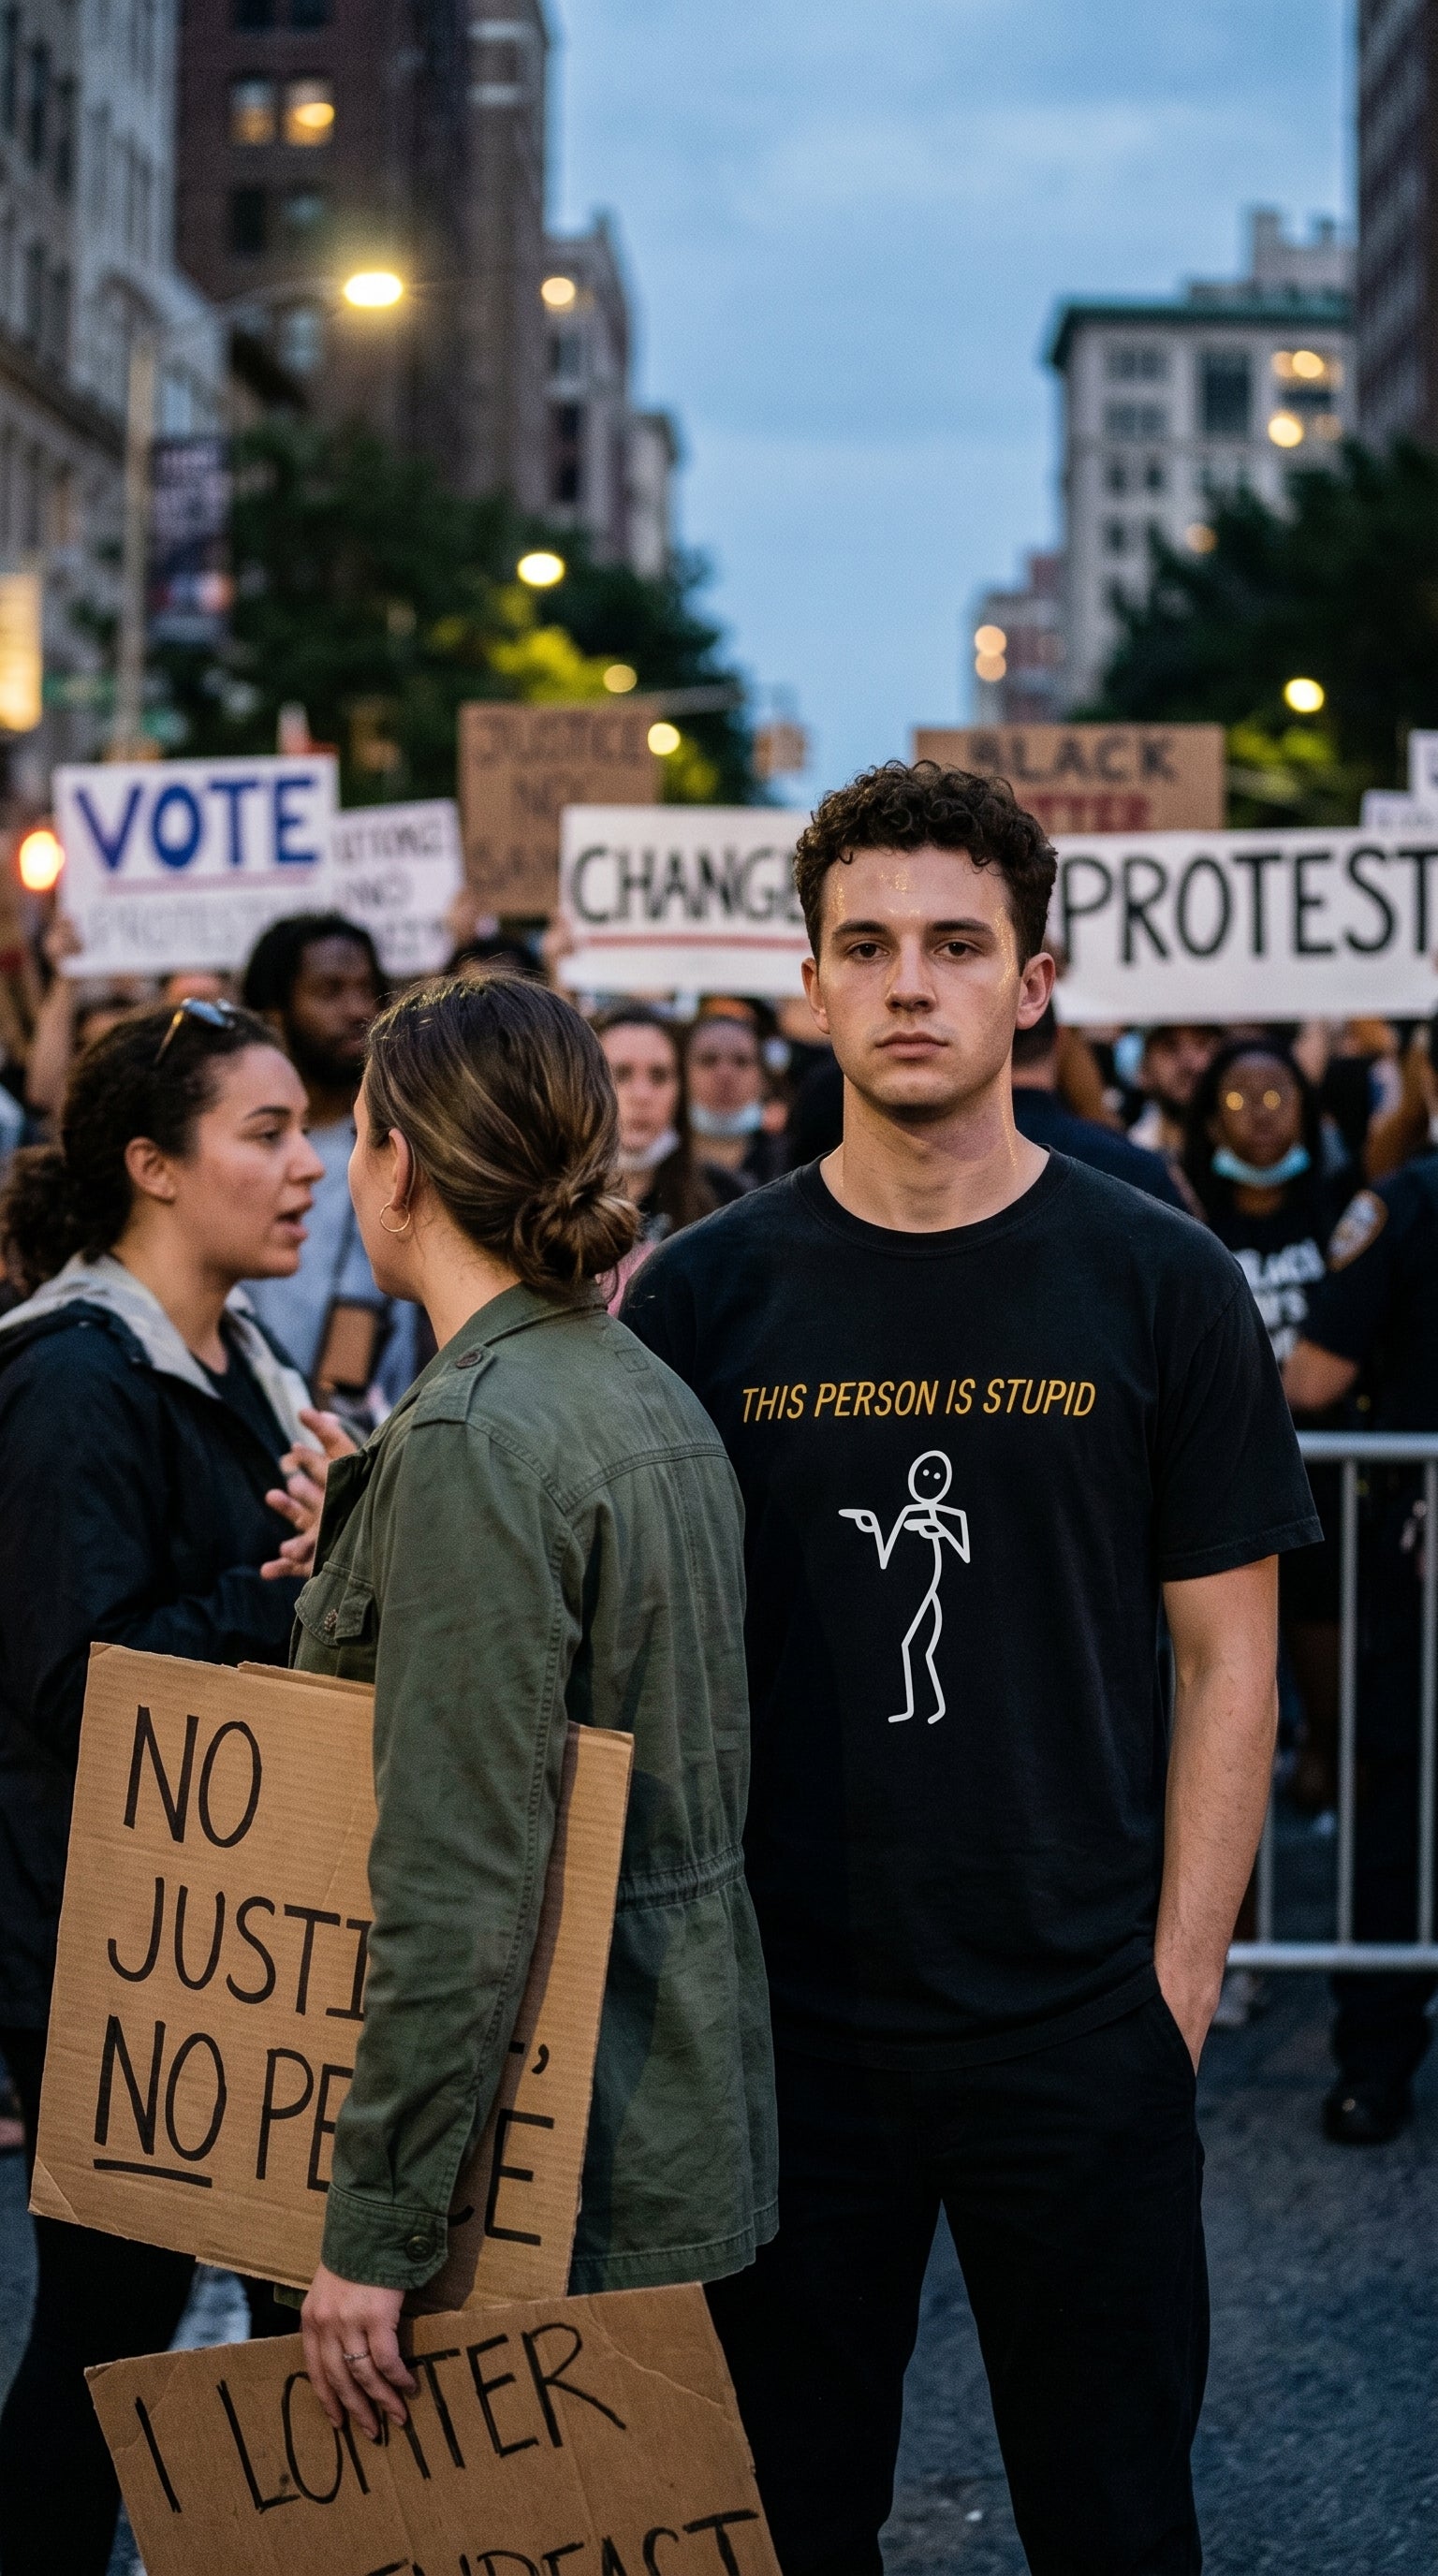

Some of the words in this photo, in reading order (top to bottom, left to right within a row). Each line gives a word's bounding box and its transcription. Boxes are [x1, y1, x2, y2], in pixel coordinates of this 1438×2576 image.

[968, 728, 1180, 784] BLACK
[75, 777, 320, 871] VOTE
[1062, 847, 1438, 966] PROTEST
[742, 1383, 807, 1423] THIS
[814, 1381, 939, 1417] PERSON
[946, 1379, 976, 1414] IS
[983, 1379, 1096, 1416] STUPID
[124, 1704, 263, 1849] NO
[95, 2013, 227, 2162] NO
[256, 2047, 554, 2247] PEE
[134, 2395, 183, 2514] I
